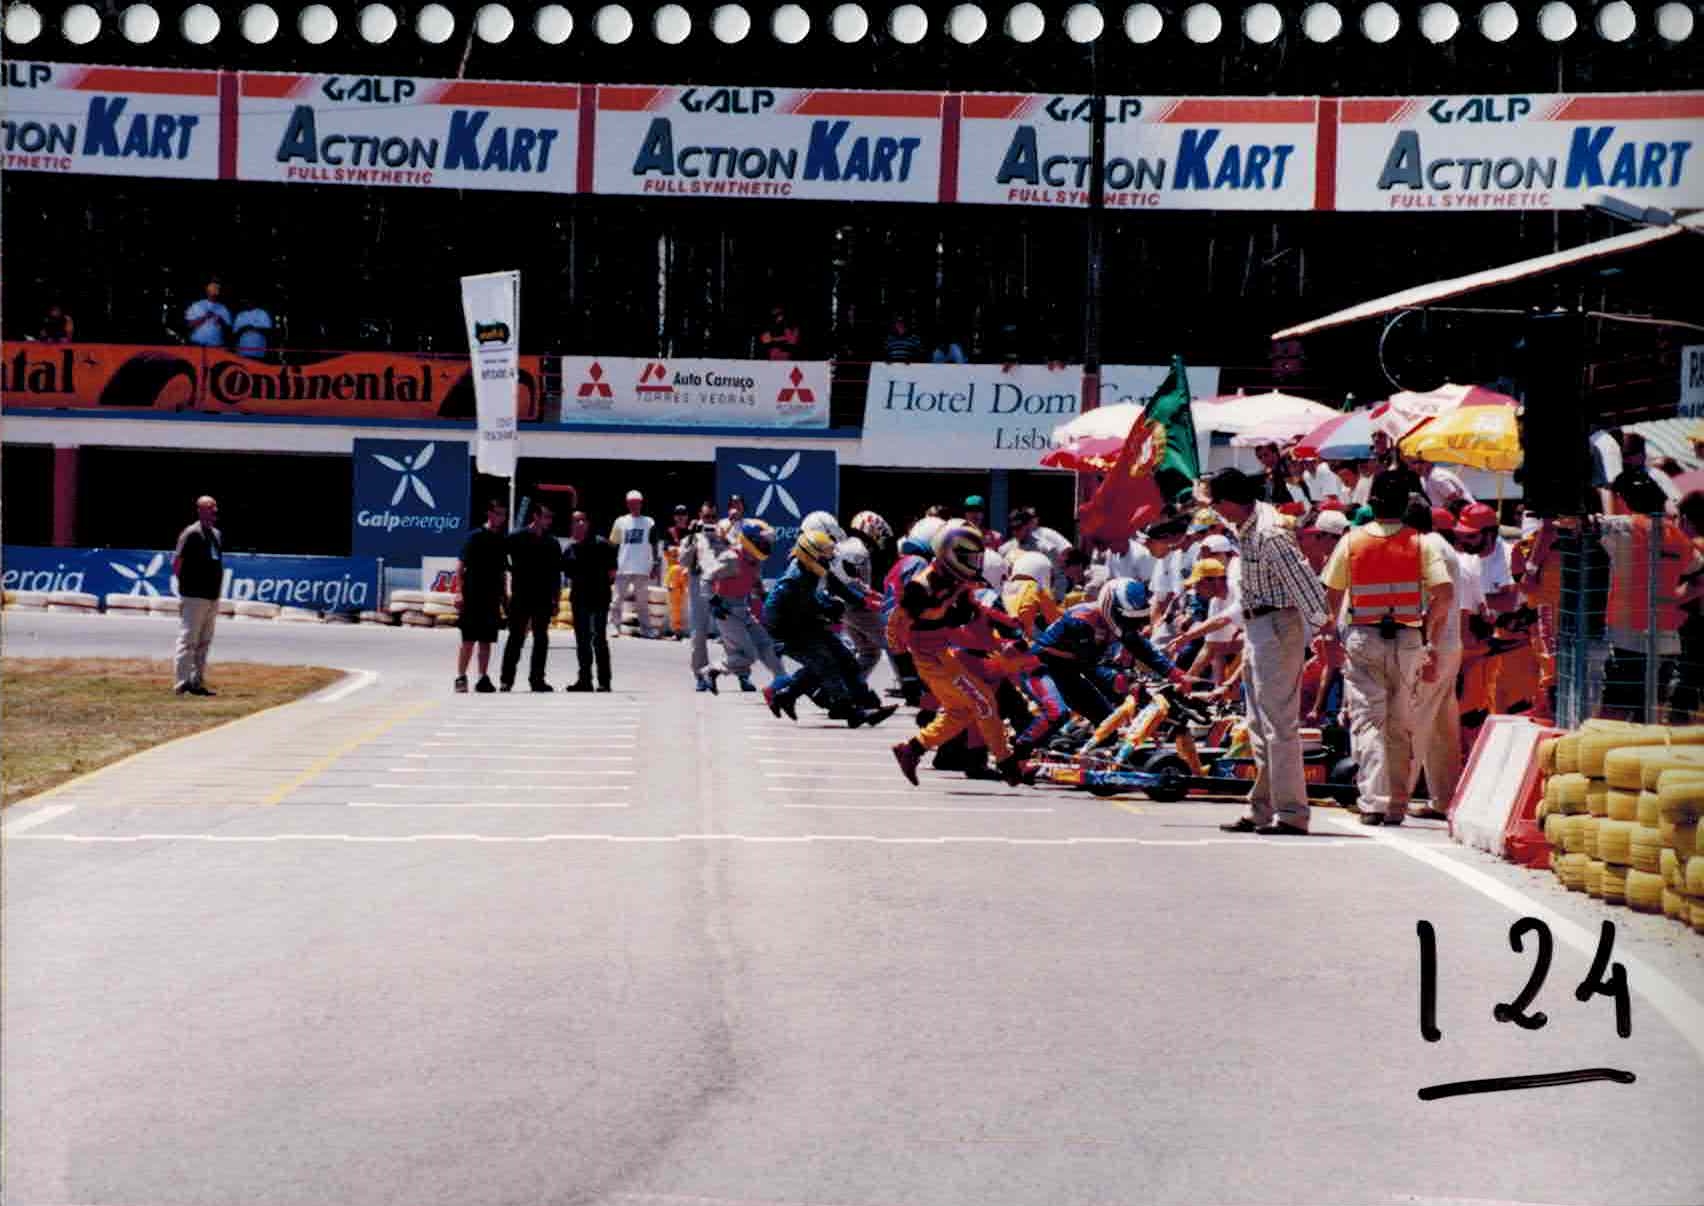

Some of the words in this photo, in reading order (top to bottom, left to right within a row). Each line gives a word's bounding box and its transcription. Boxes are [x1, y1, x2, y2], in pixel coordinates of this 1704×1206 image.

[1, 63, 53, 88] LP
[322, 77, 415, 103] GALP
[680, 89, 775, 114] GALP
[1427, 97, 1532, 123] GALP
[82, 96, 199, 160] KART
[276, 105, 440, 169] ACTION
[443, 110, 559, 173] KART
[632, 117, 799, 180] ACTION
[803, 120, 921, 183] KART
[997, 125, 1166, 190] ACTON
[1173, 129, 1295, 191] KART
[1377, 130, 1557, 191] ACTION
[1564, 126, 1693, 189] KART
[287, 165, 331, 181] FULL
[333, 168, 433, 185] SYNTHETIC
[643, 179, 688, 194] FULL
[689, 181, 793, 197] SYNTHETIC
[1008, 188, 1052, 203] FULL
[1055, 190, 1161, 207] SYNHETIC
[1390, 194, 1437, 209] FULL
[1442, 192, 1553, 208] SYNTHETIC
[209, 360, 433, 404] Continental
[673, 371, 702, 386] Auto
[884, 380, 976, 414] Hotel
[990, 383, 1077, 415] Dom
[357, 510, 463, 534] Galpenergia
